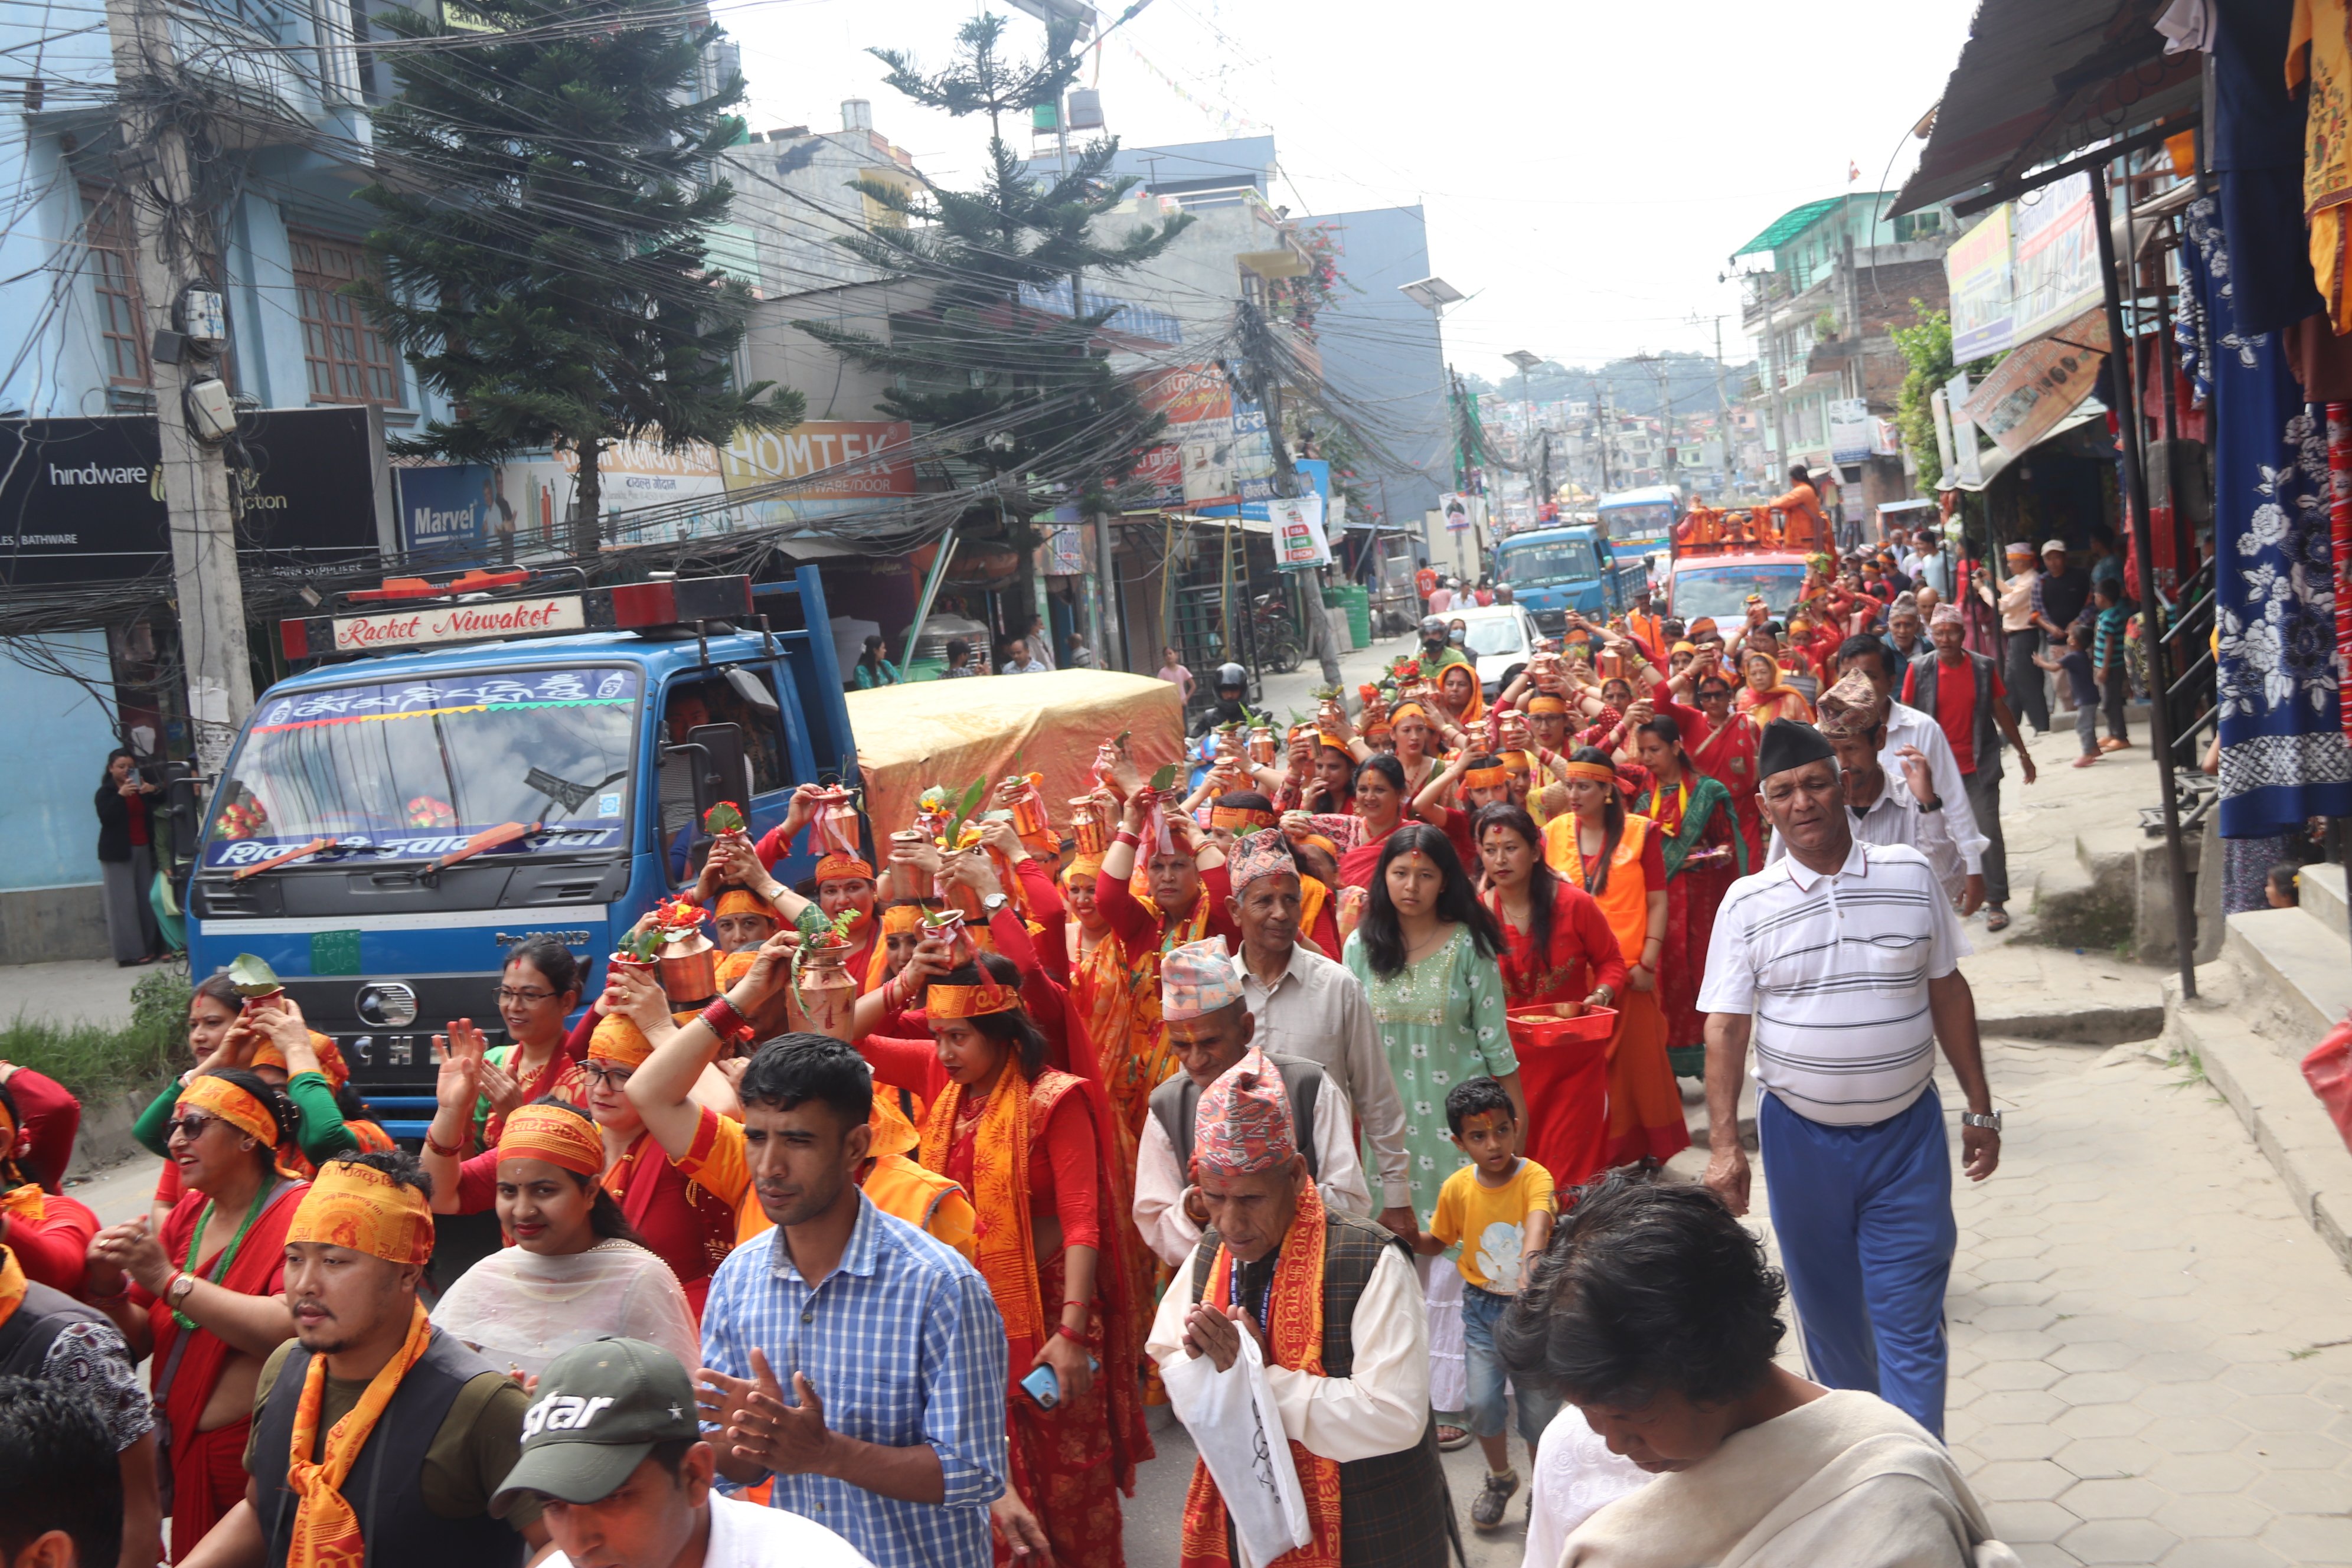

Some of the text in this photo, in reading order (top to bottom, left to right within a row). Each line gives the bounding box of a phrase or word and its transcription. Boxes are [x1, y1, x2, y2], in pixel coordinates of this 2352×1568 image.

[729, 433, 893, 478] HOMTEK
[50, 462, 147, 485] hindware
[625, 476, 677, 491] टायल्स गोदाम
[415, 503, 474, 535] Marvel
[21, 534, 78, 545] BATHWARE
[1421, 578, 1432, 590] 10
[338, 616, 421, 647] Racket
